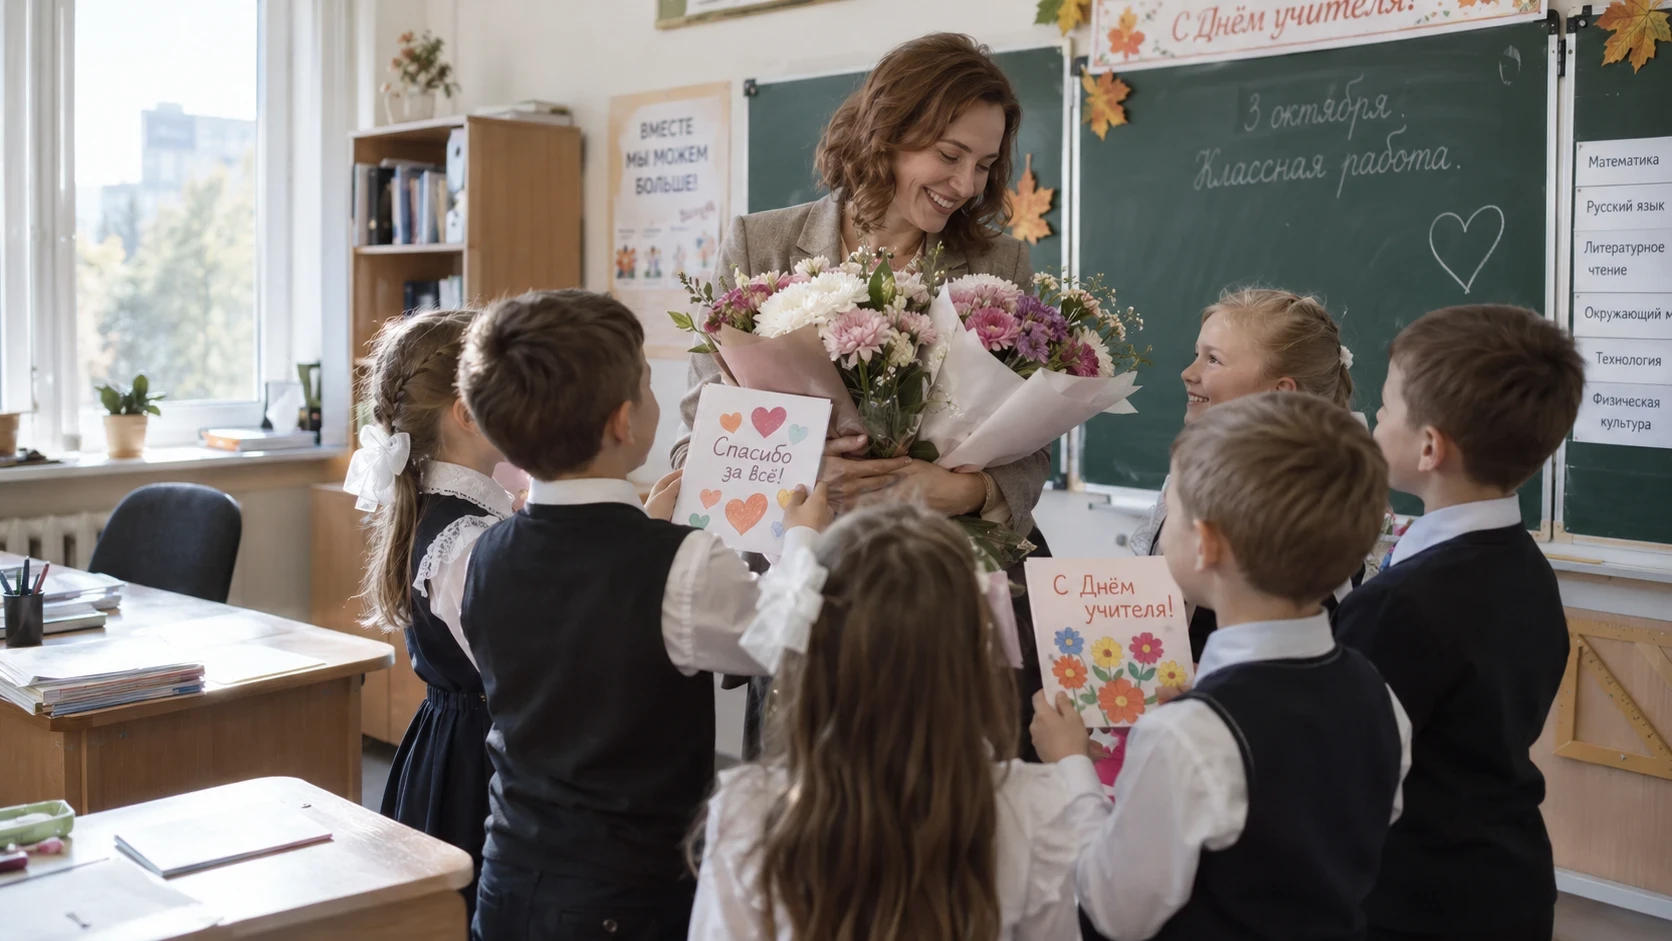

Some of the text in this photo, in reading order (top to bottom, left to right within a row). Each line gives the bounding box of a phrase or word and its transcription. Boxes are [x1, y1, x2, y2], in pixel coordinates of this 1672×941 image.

[1172, 10, 1189, 42] С
[1193, 6, 1264, 43] Днём
[1244, 93, 1260, 131] 3
[640, 117, 693, 140] ВМЕСТЕ
[626, 144, 708, 169] МЫ МОЖЕМ
[1589, 155, 1659, 168] Математика
[1193, 148, 1327, 190] Классная
[635, 173, 698, 195] БОЛЬШЕ!
[1586, 199, 1665, 216] Русский язык
[1584, 241, 1665, 256] Литературное
[1588, 265, 1628, 276] чтение
[1584, 305, 1662, 322] Окружающий
[1596, 351, 1662, 366] Технология
[1592, 392, 1660, 408] Физическая
[1600, 418, 1652, 432] культура
[713, 435, 792, 464] Спасибо
[721, 464, 785, 485] за всё!
[1053, 574, 1135, 598] С Днём
[1084, 594, 1174, 625] учителя!
